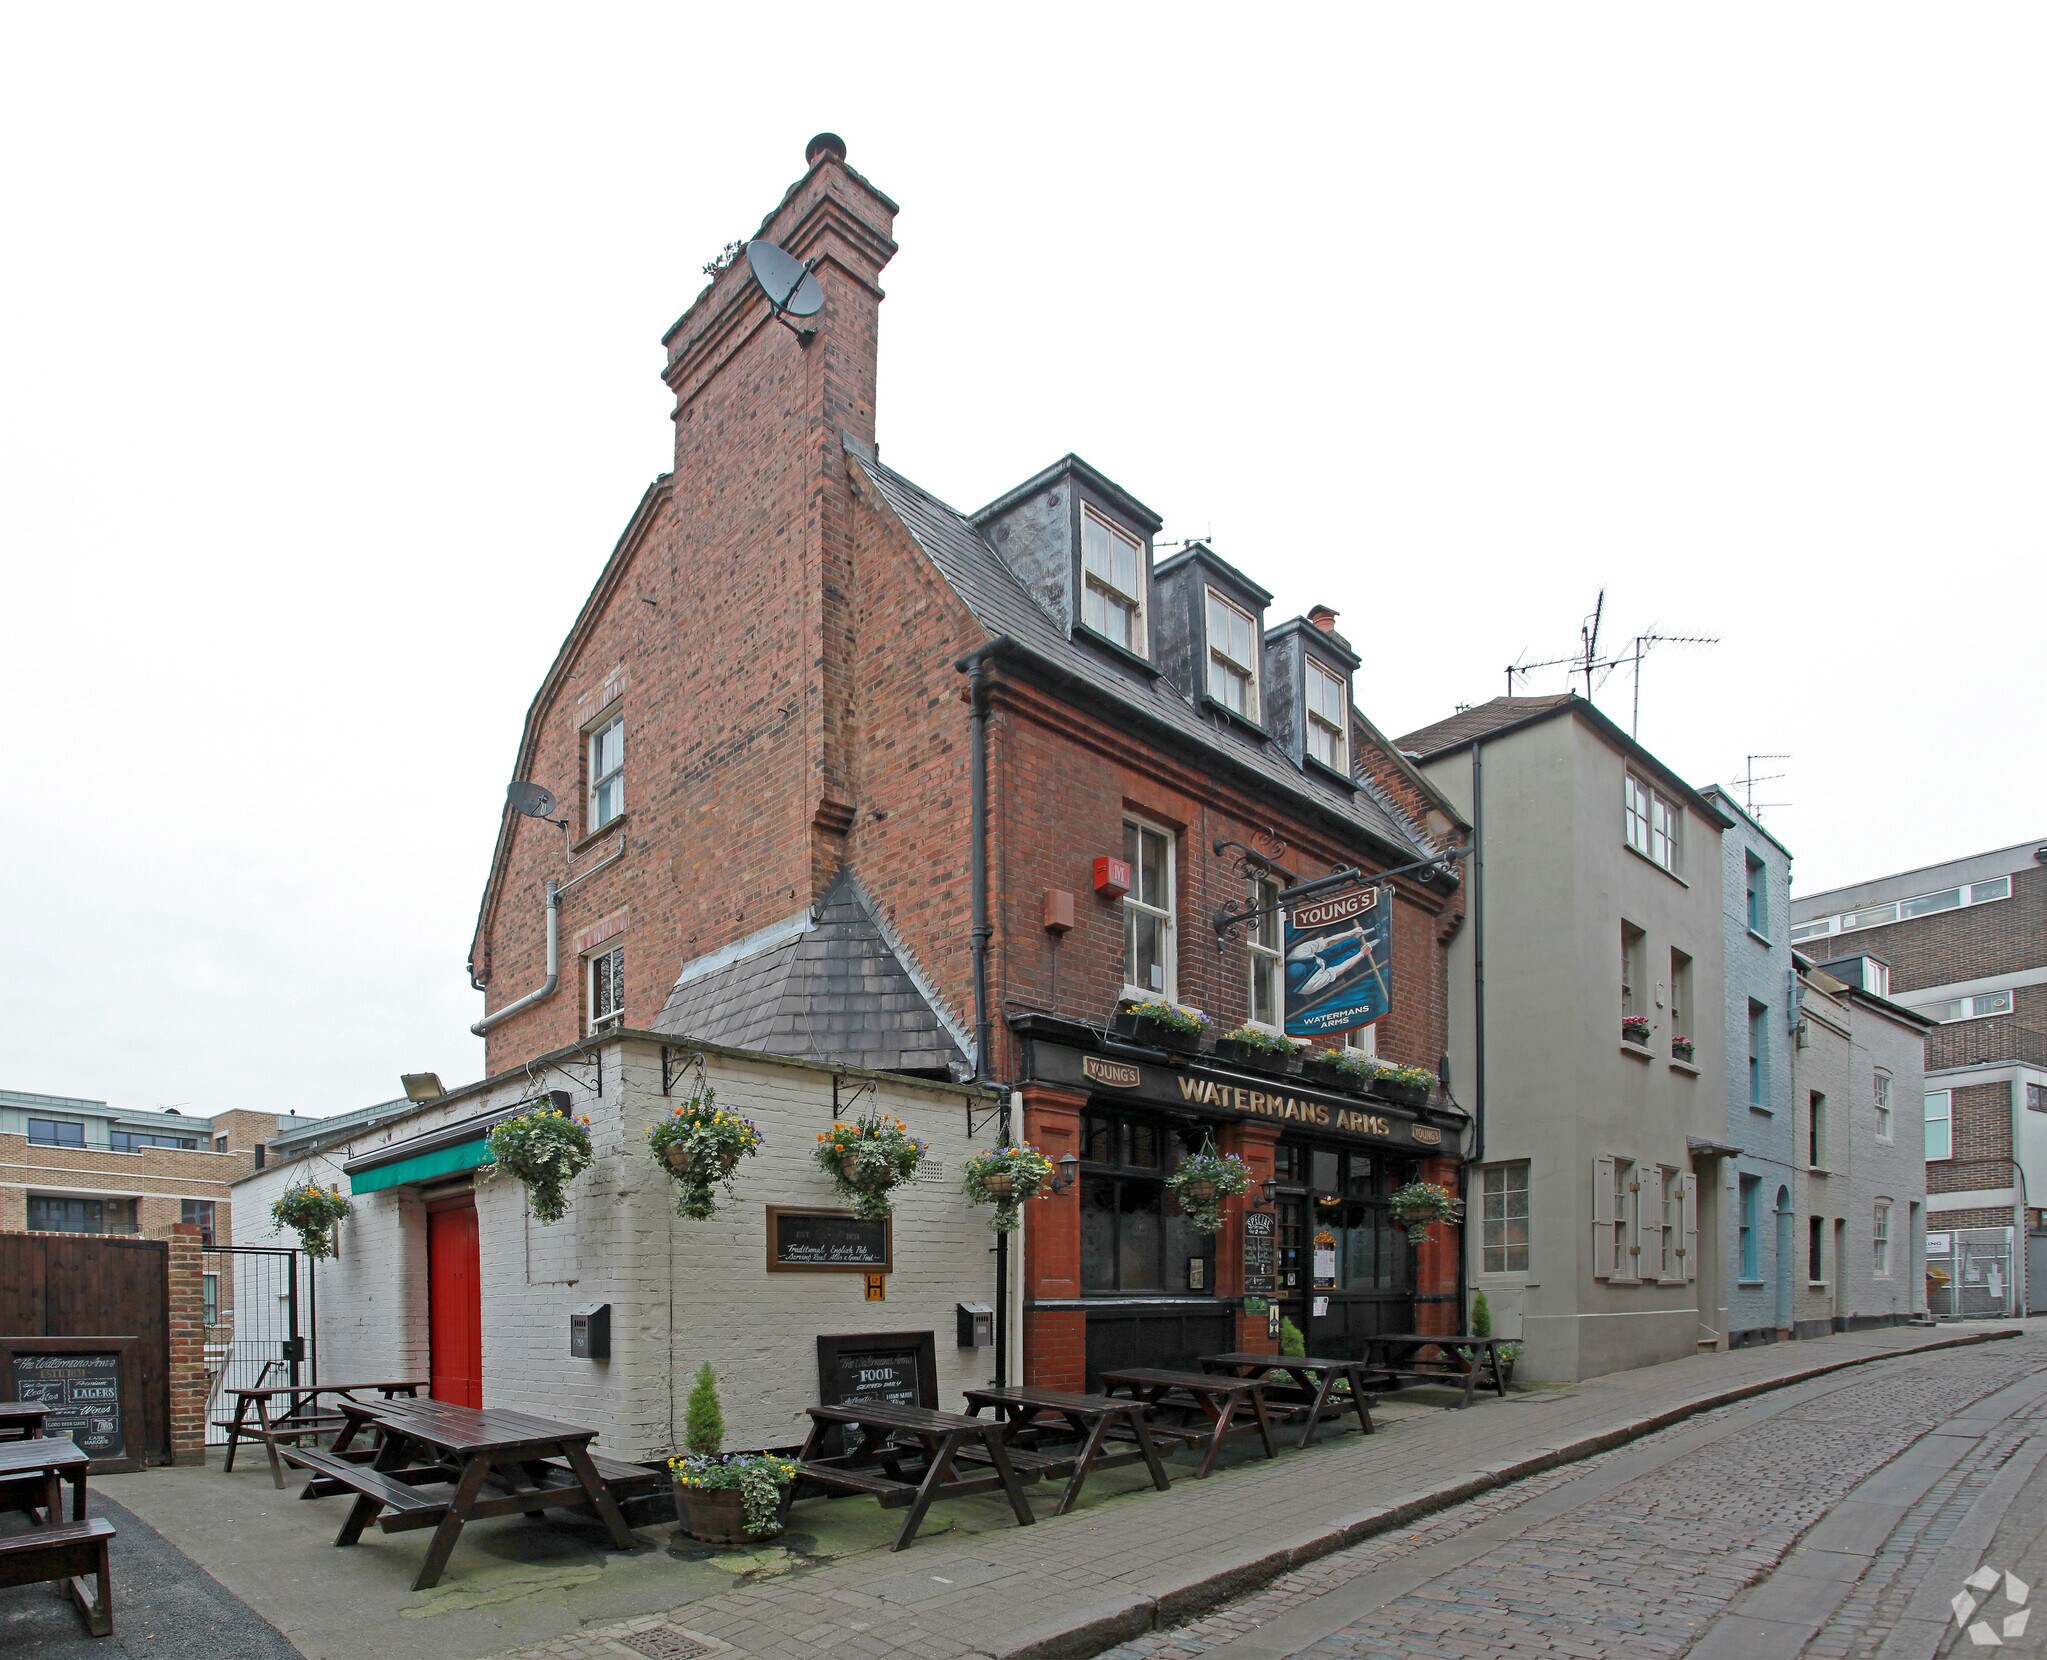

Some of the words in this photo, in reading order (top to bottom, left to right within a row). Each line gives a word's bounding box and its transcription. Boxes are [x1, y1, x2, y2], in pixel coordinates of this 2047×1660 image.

[1114, 864, 1124, 882] M
[1300, 894, 1370, 924] YOUNG'S
[1304, 1005, 1370, 1025] WATERMANS
[1320, 1017, 1350, 1029] ARMS
[1089, 1061, 1136, 1082] YOUNG'S
[1177, 1075, 1330, 1126] WATERMANS
[1336, 1108, 1390, 1137] ARMS
[1414, 1129, 1440, 1143] YOUNG'S
[1247, 1214, 1271, 1229] SPECIAL
[830, 1244, 853, 1256] English
[855, 1246, 868, 1254] Pub
[13, 1357, 34, 1370] The
[860, 1368, 893, 1382] FOOD
[24, 1387, 47, 1398] Real
[72, 1388, 115, 1399] LAGERS
[80, 1405, 111, 1416] Wines
